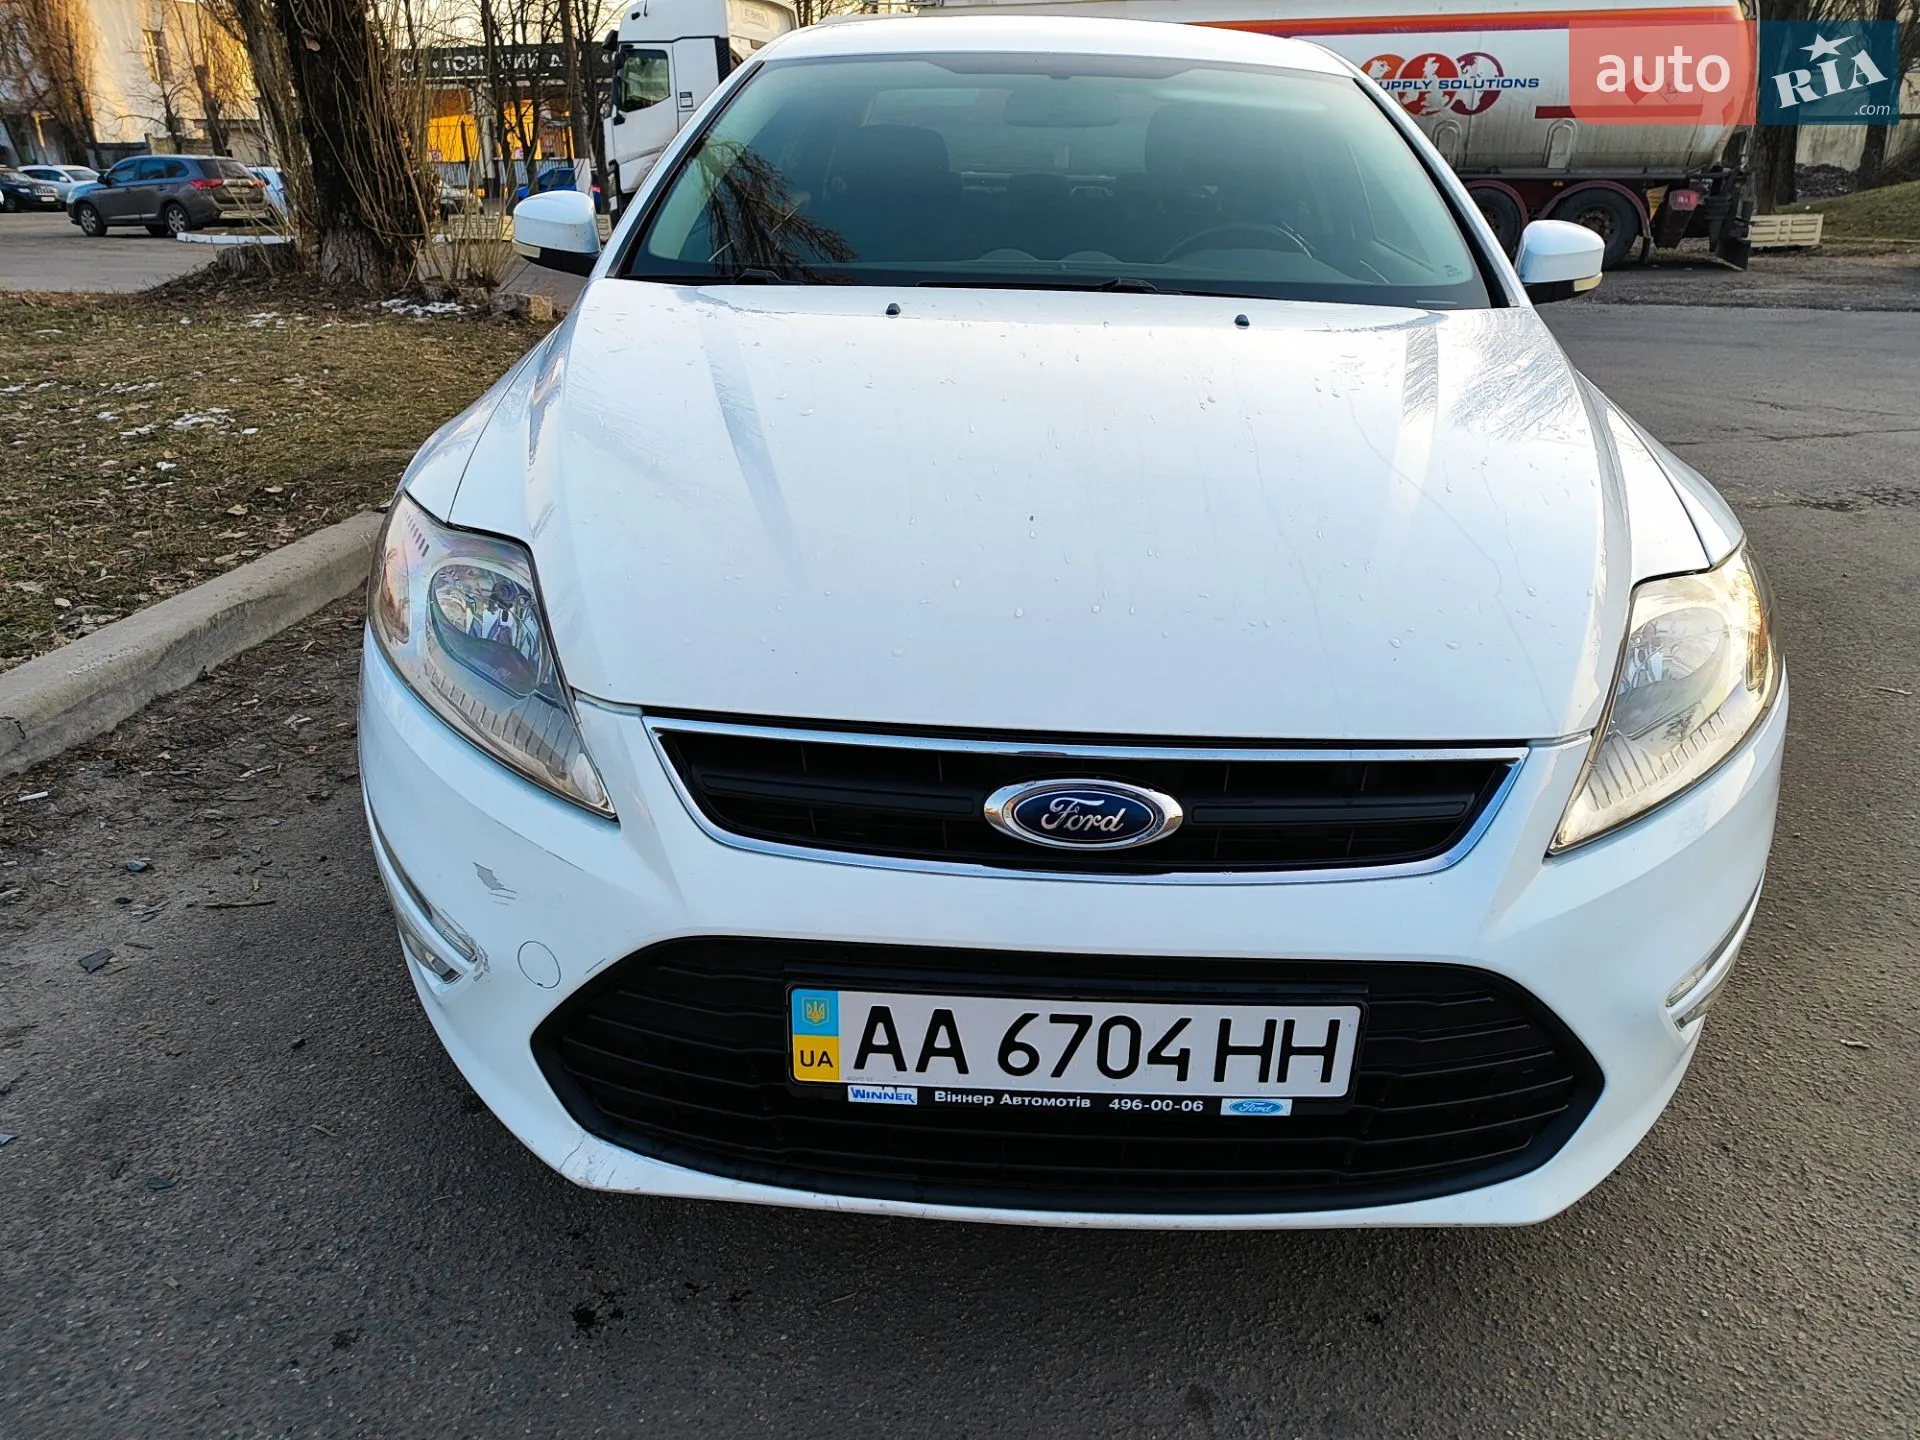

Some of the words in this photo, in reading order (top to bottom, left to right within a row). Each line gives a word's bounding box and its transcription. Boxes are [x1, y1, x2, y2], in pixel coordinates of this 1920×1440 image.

[1378, 80, 1432, 90] UPPLY
[1438, 78, 1540, 89] SOLUTIONS
[1041, 797, 1126, 832] Ford
[853, 1005, 969, 1075] AA
[997, 1012, 1192, 1082] 6704
[1213, 1018, 1341, 1083] HH
[799, 1050, 834, 1068] UA
[850, 1086, 916, 1103] WINNER
[934, 1090, 994, 1106] Віннер
[1000, 1093, 1091, 1108] Автомотів
[1108, 1098, 1204, 1112] 496-00-06
